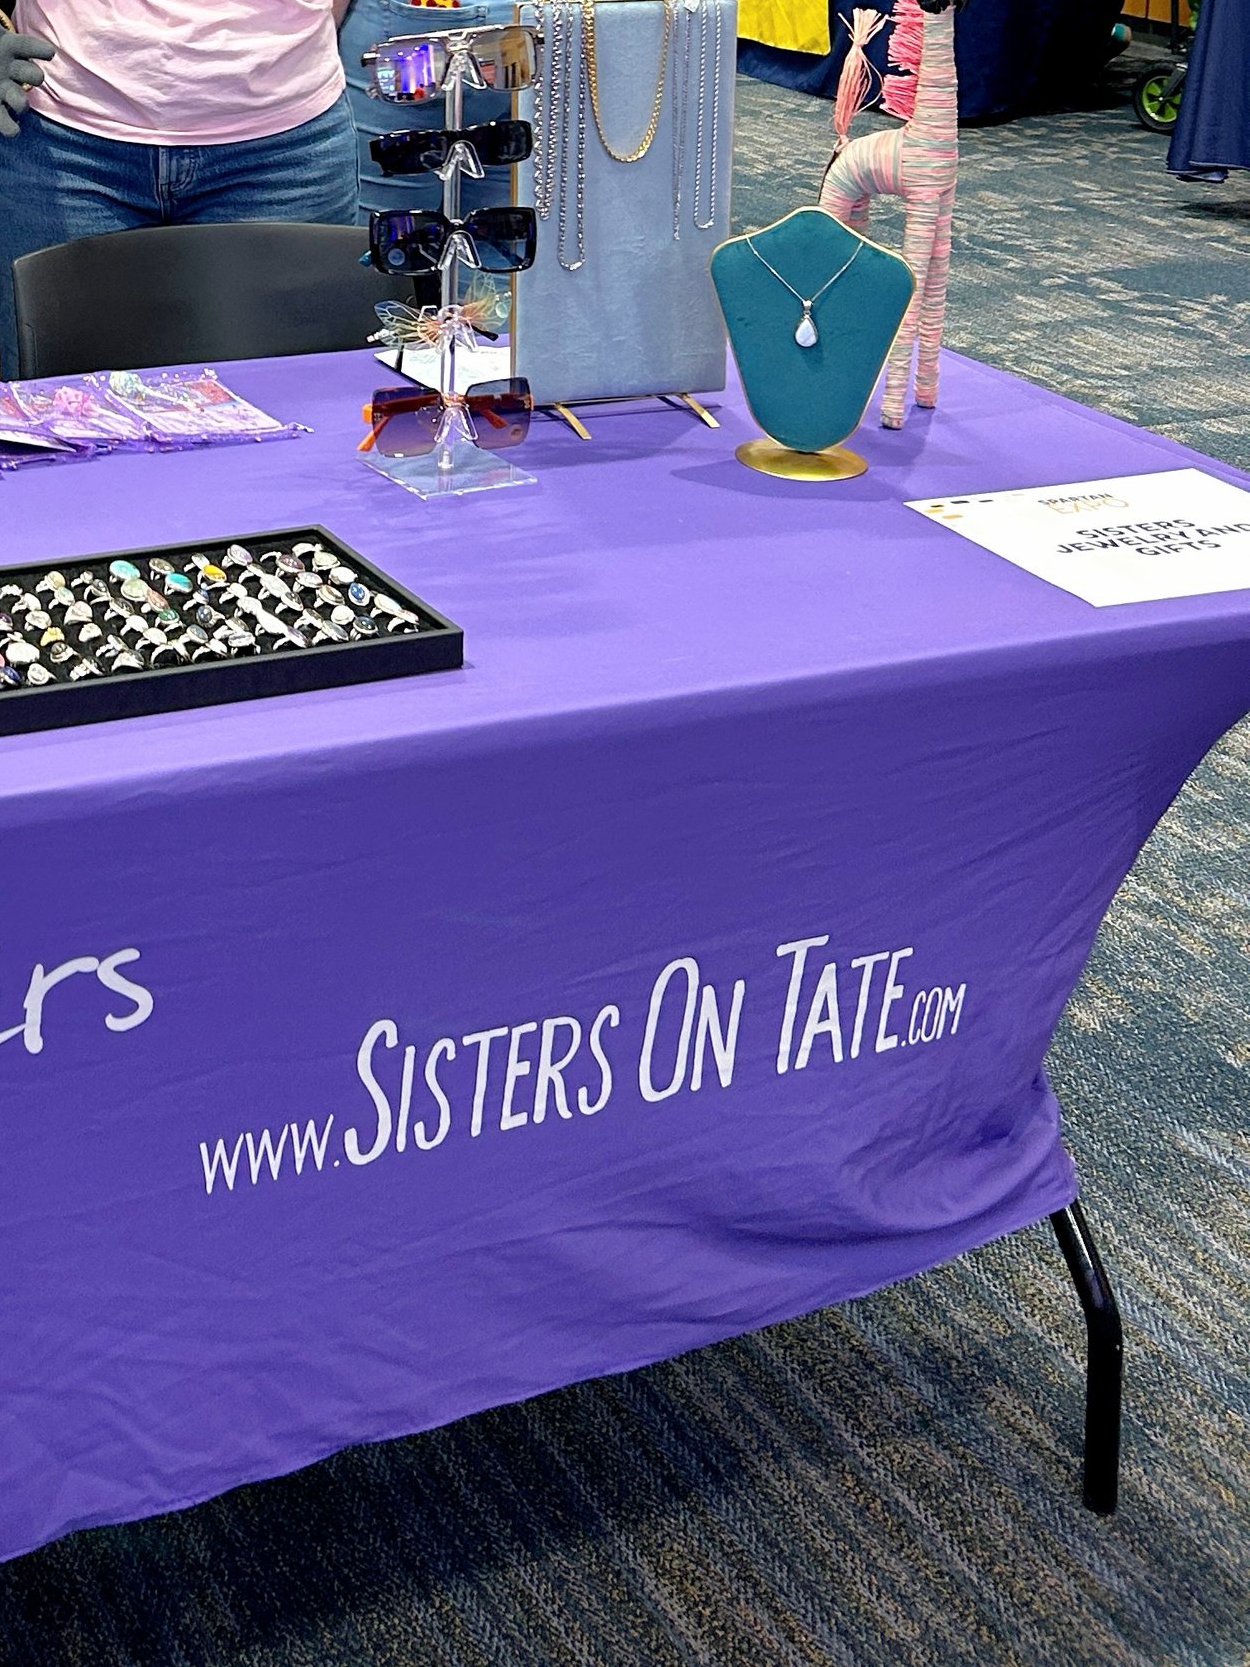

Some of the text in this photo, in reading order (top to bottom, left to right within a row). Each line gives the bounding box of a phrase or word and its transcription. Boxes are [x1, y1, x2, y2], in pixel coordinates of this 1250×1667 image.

[1038, 493, 1114, 505] SPARTAN
[1056, 523, 1250, 553] JEWELRY AND
[1075, 519, 1196, 539] SISTERS
[1135, 540, 1222, 556] GIFTS
